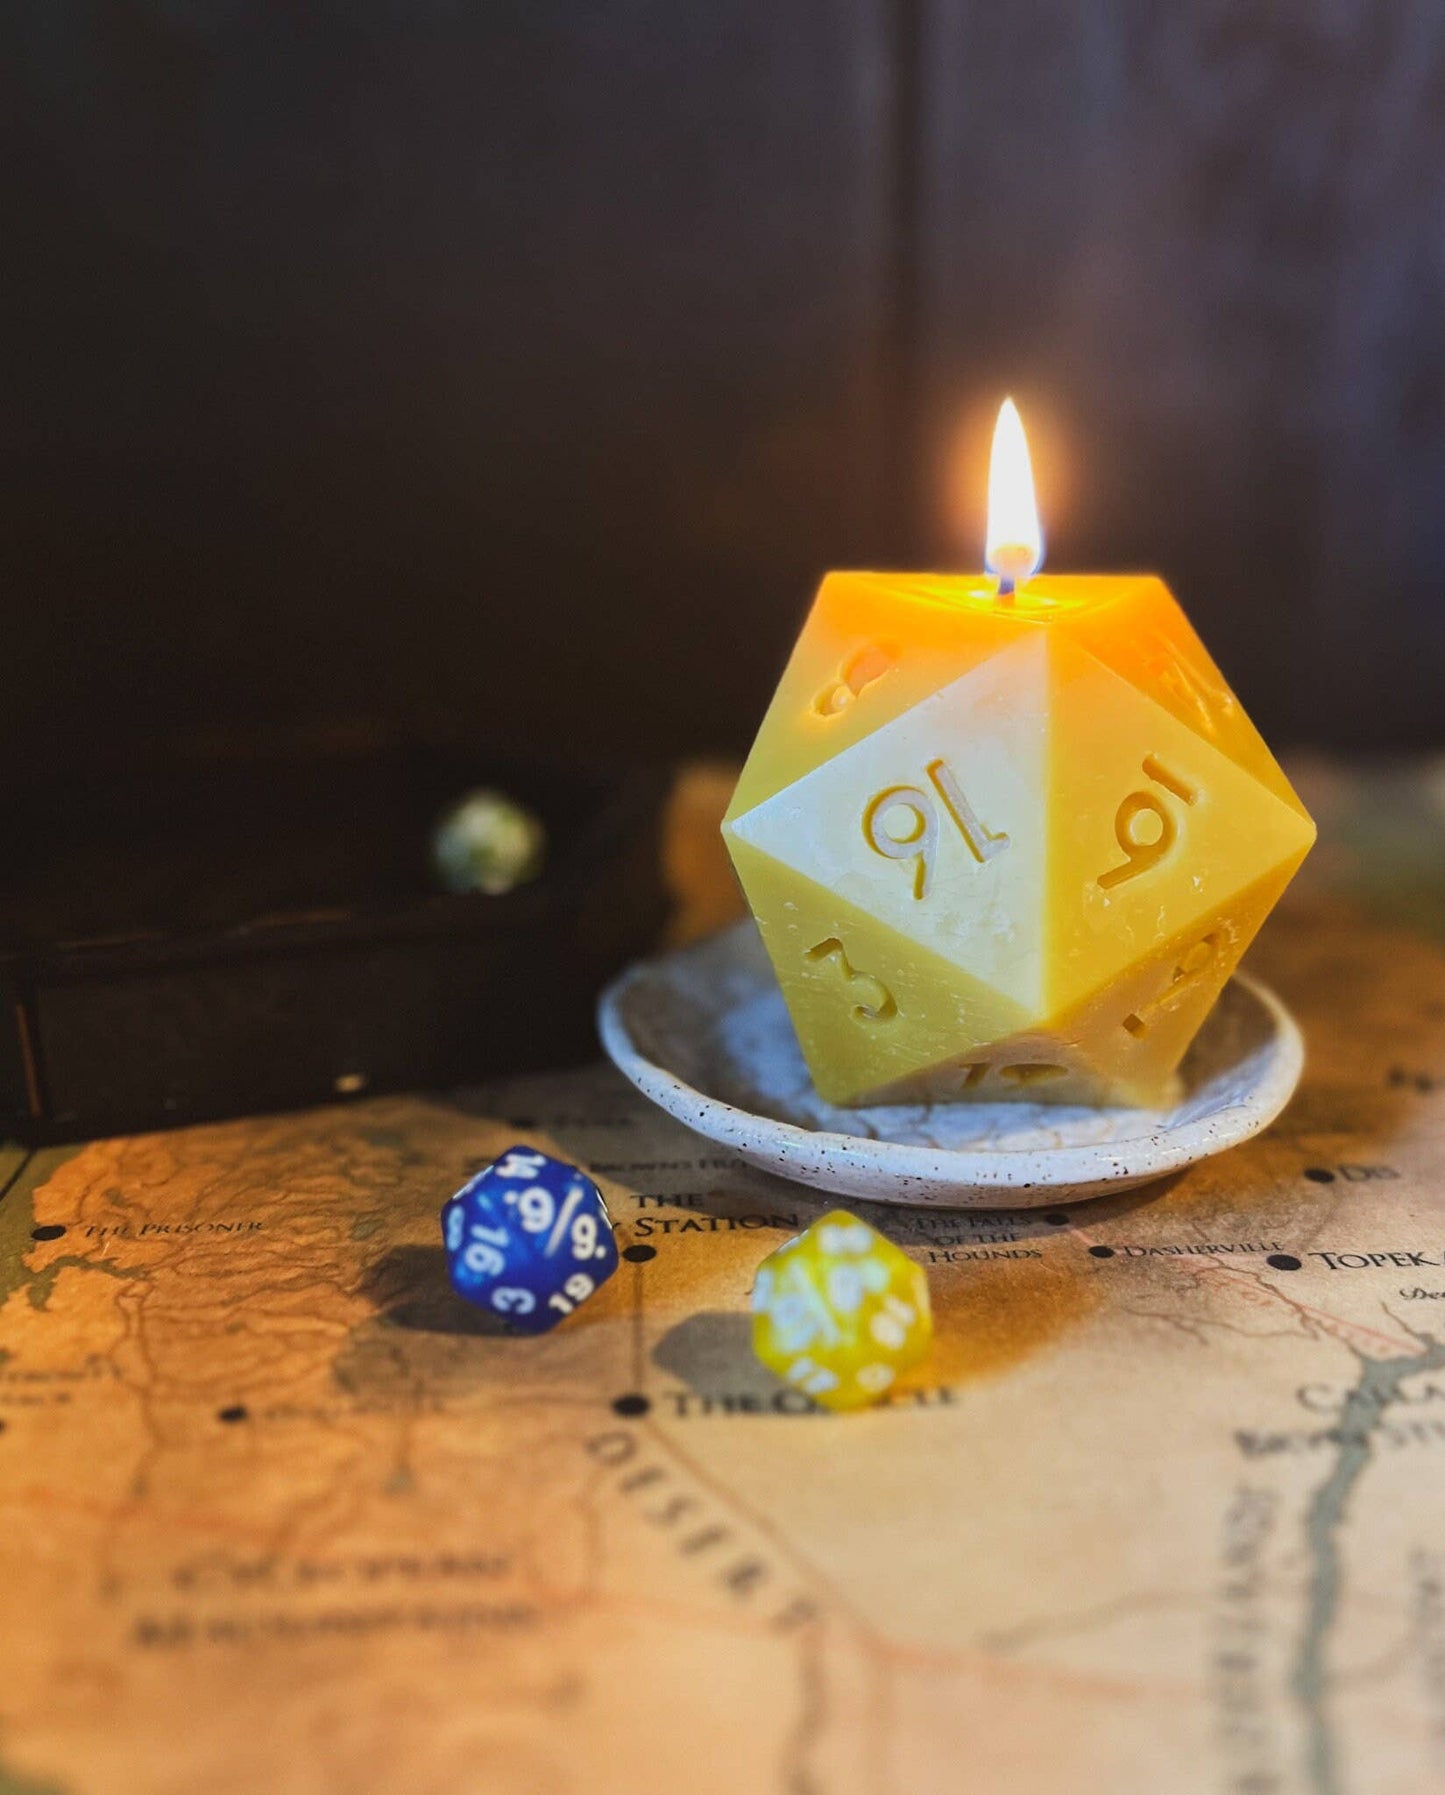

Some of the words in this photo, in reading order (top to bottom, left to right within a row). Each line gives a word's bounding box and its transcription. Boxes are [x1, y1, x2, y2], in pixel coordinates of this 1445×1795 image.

[802, 936, 898, 1025] 3
[630, 1194, 703, 1209] THE
[138, 1221, 264, 1236] PRISONER
[634, 1213, 799, 1238] STATION
[928, 1248, 1043, 1263] HOUNDS
[1124, 1241, 1287, 1259] DASHERVILLE
[1307, 1250, 1445, 1271] TOPEK
